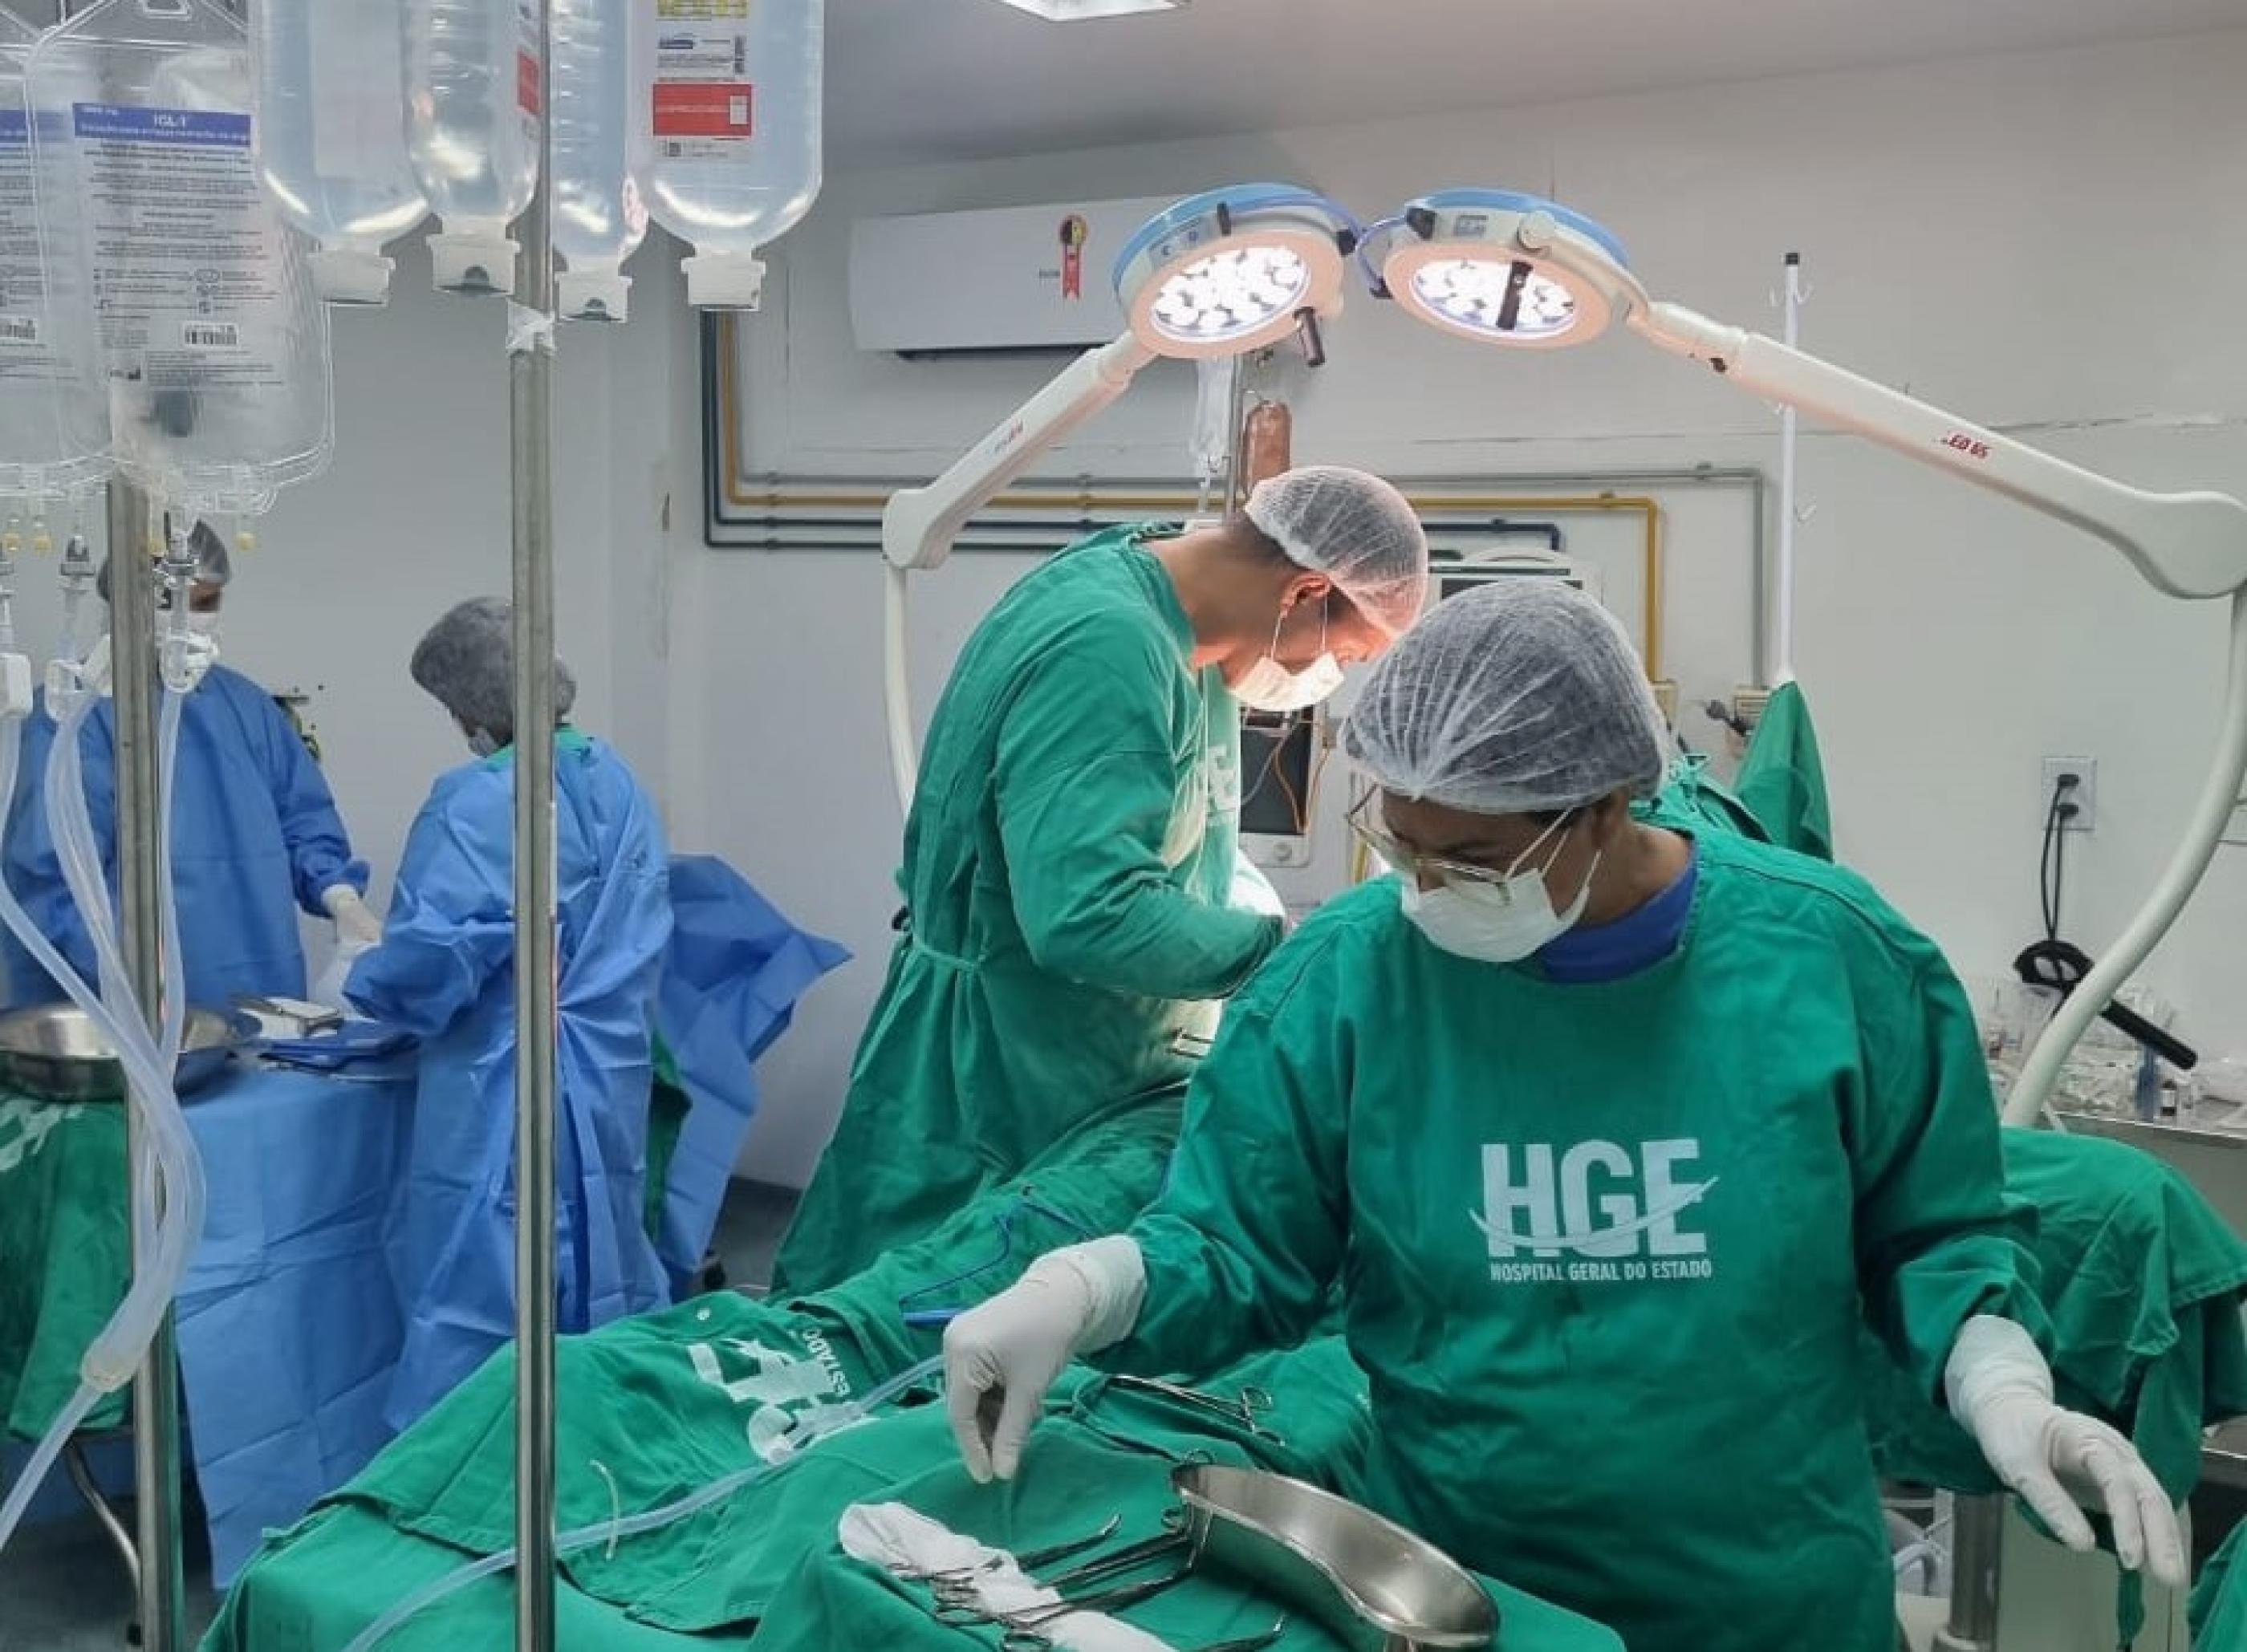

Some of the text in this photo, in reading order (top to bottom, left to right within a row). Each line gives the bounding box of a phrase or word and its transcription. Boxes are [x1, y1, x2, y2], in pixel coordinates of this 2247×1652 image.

[1481, 1139, 1708, 1258] HGE
[1490, 1259, 1712, 1281] HOSPITAL GERAL DO ESTADO
